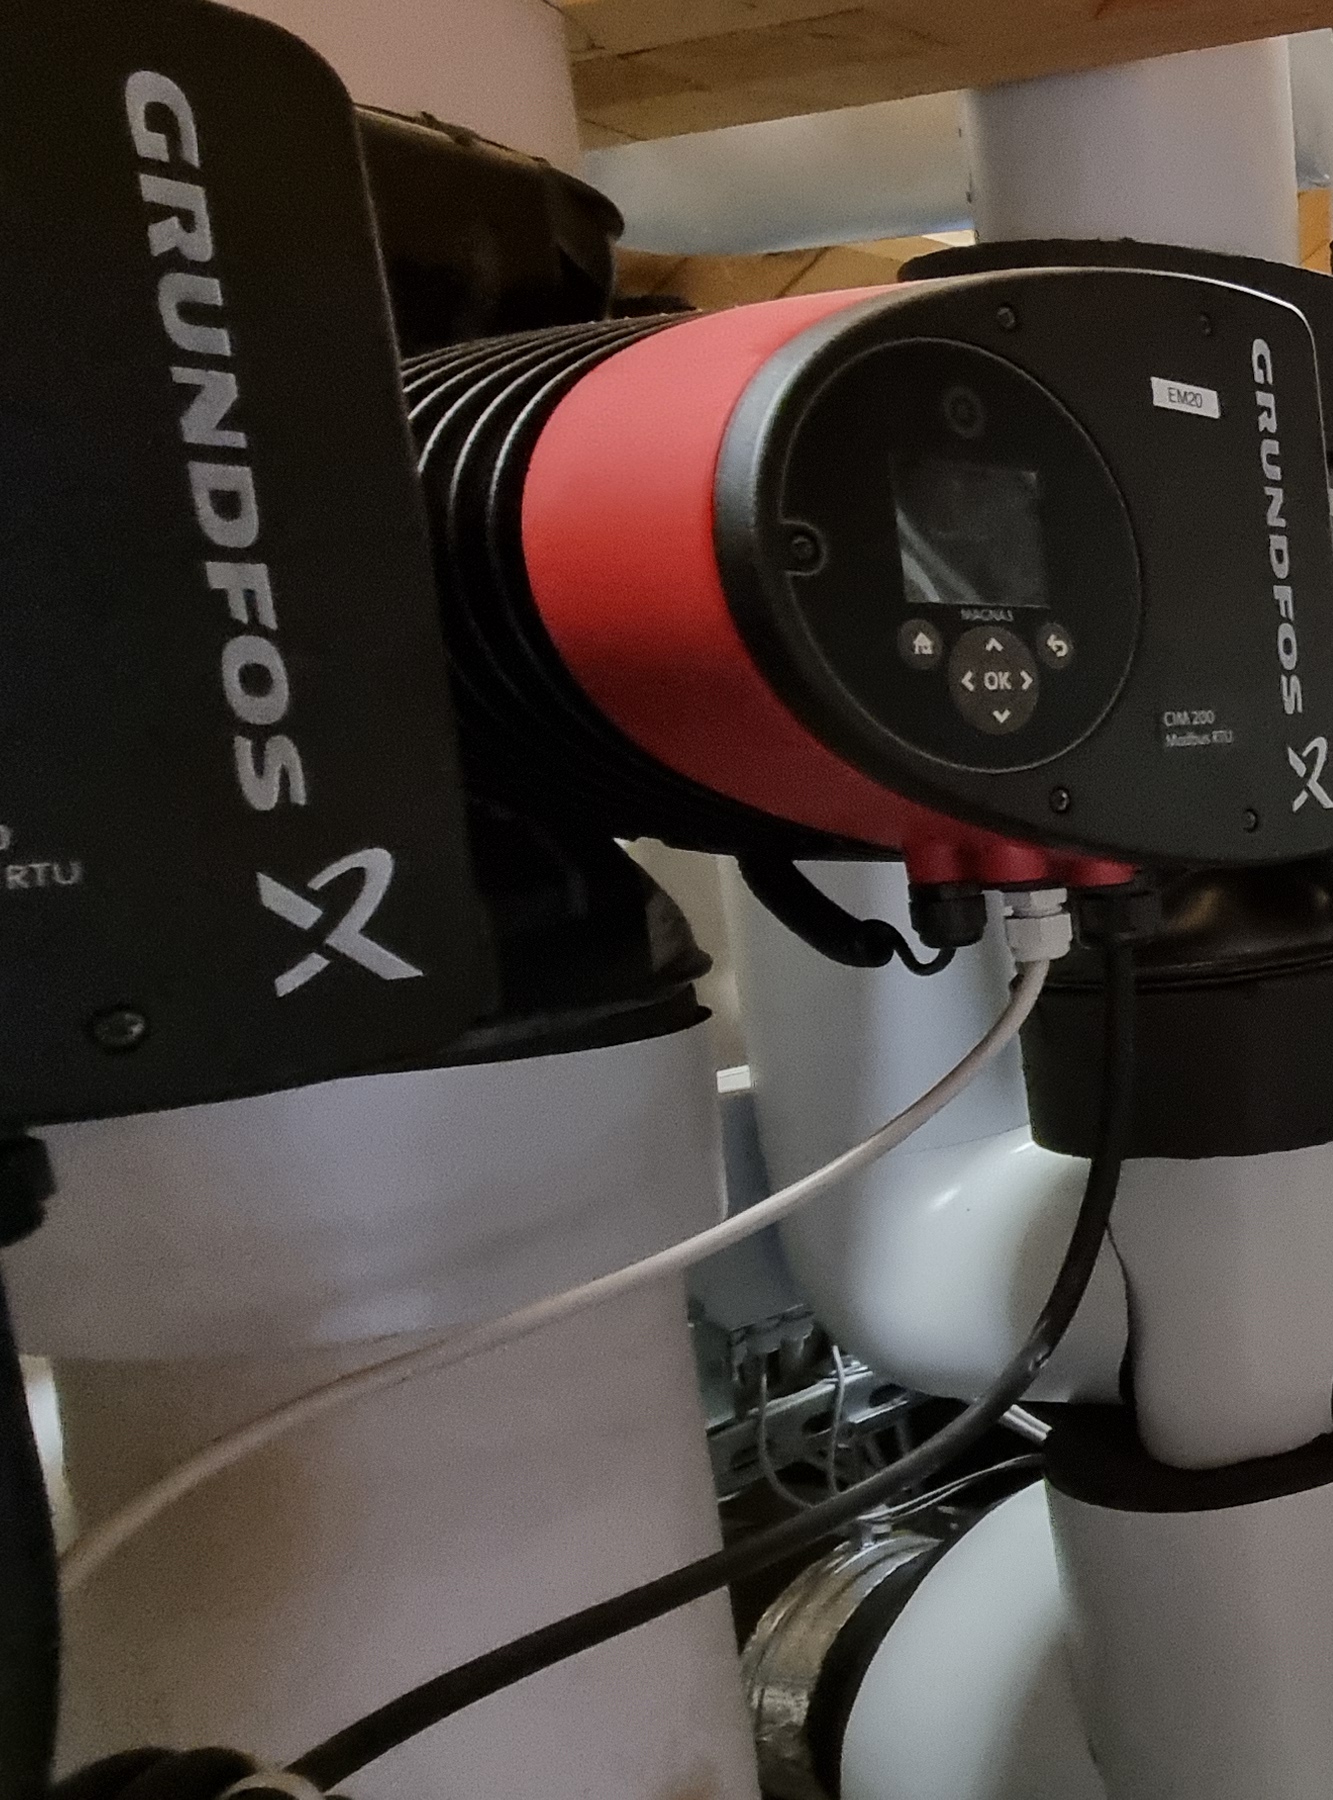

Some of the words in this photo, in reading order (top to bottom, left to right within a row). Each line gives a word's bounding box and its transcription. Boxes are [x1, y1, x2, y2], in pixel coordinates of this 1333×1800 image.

[1167, 386, 1203, 408] EM20
[124, 70, 307, 811] GRUNDFOS
[1251, 338, 1303, 715] GRUNDFOS
[983, 670, 1012, 690] OK
[1191, 710, 1215, 725] 200
[6, 862, 81, 889] RTU
